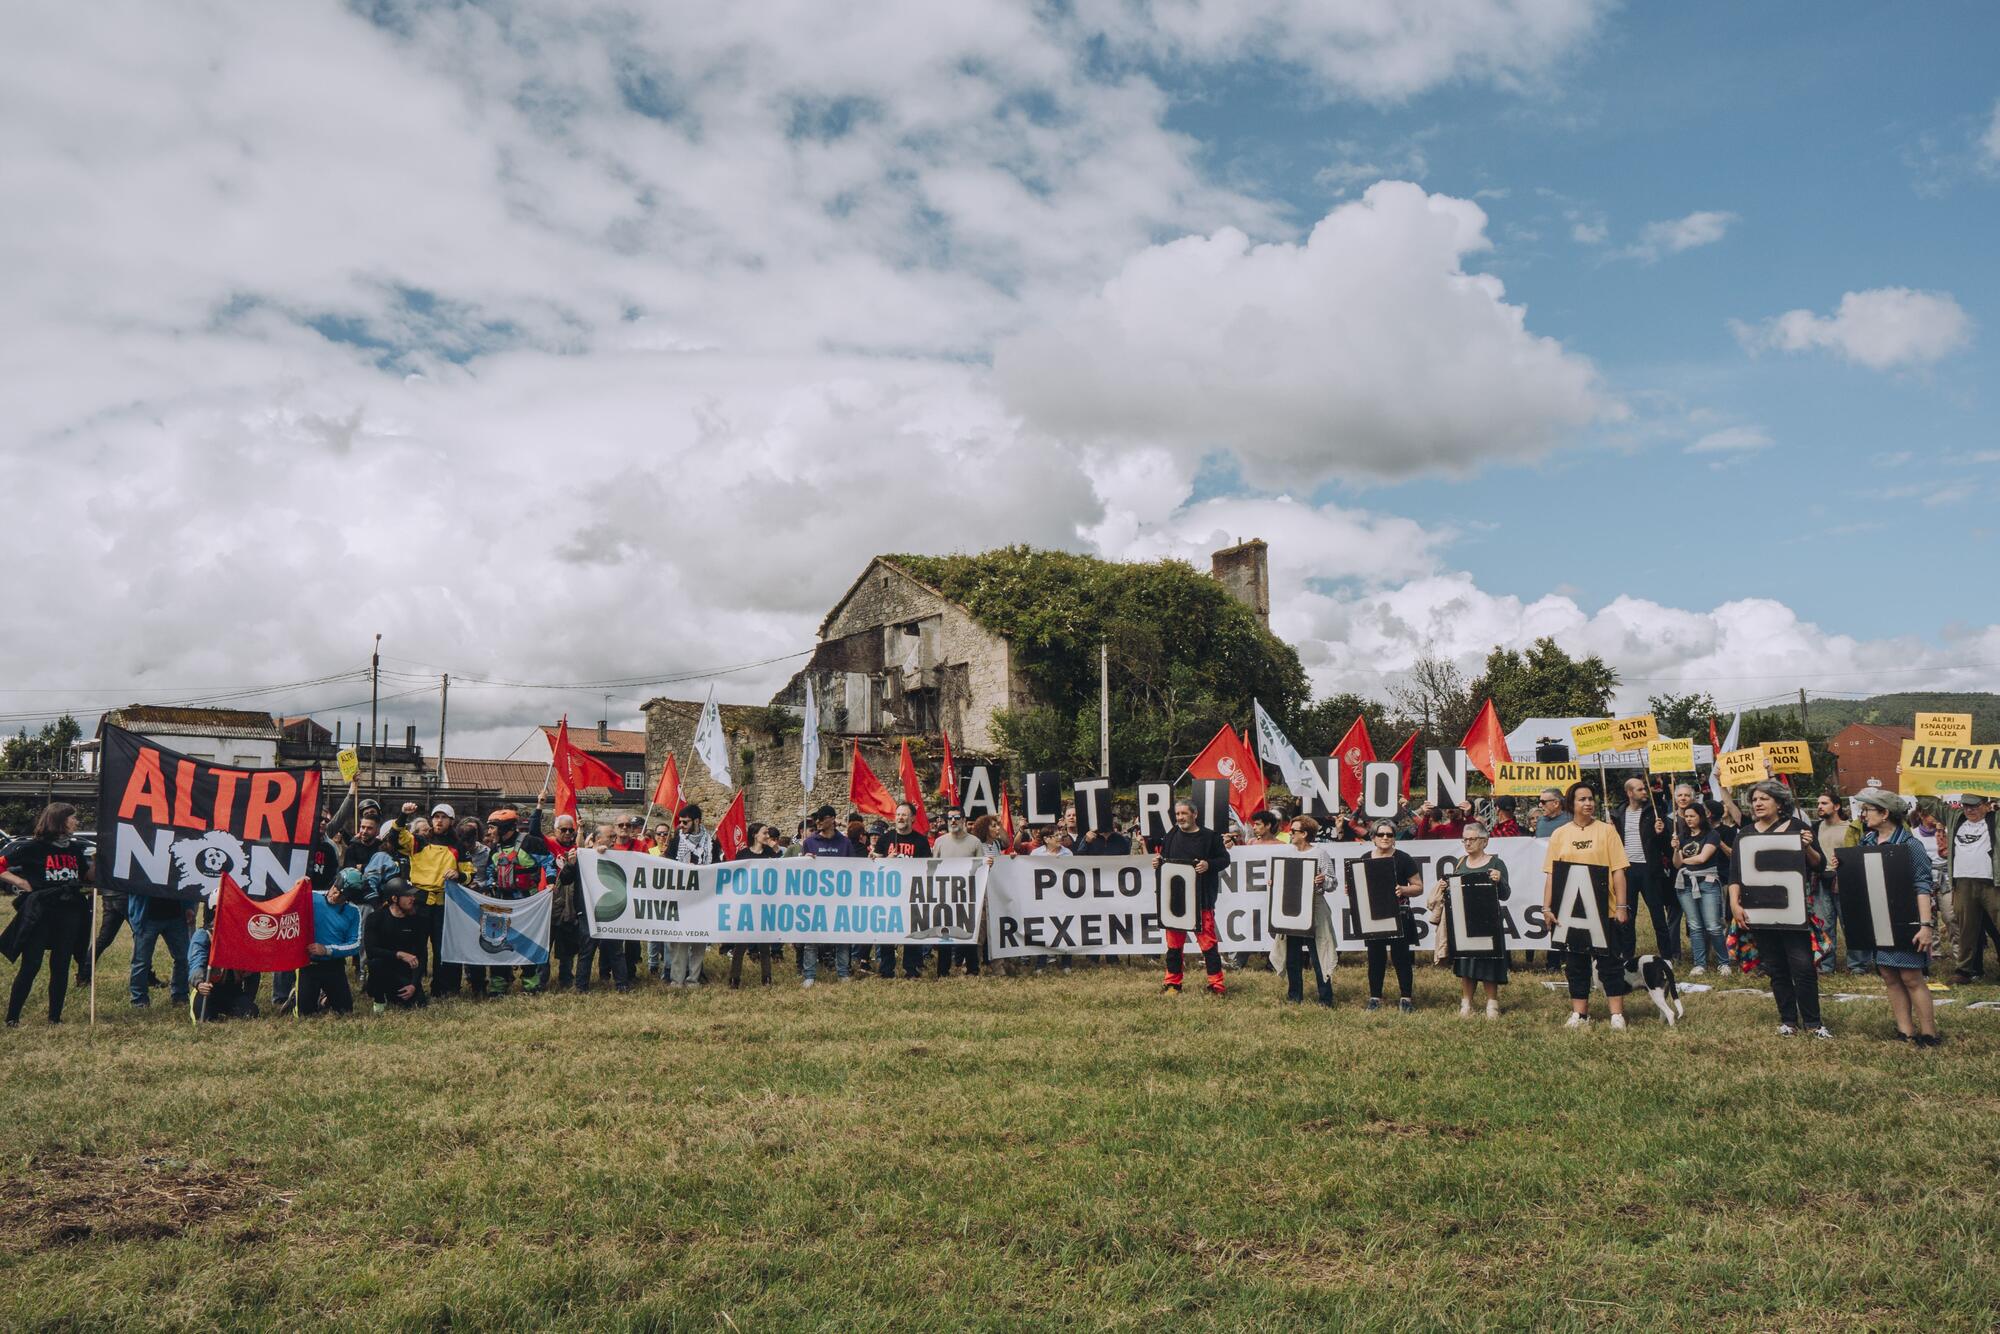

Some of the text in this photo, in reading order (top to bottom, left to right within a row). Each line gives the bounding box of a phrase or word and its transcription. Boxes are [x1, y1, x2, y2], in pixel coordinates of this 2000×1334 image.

[1576, 724, 1596, 737] ALTRI
[1618, 720, 1647, 732] ALTRI
[1622, 729, 1647, 741] NON
[1652, 742, 1672, 752] ALTRI
[1672, 741, 1689, 751] NON
[1769, 746, 1799, 755] ALTRI
[1726, 753, 1755, 765] ALTRI
[1773, 755, 1799, 764] NON
[1910, 745, 1983, 769] ALTRI
[1500, 764, 1577, 780] ALTRI NON
[1730, 763, 1754, 774] NON
[118, 746, 320, 844] ALTRI
[45, 854, 78, 869] ALTRI
[633, 867, 700, 891] A ULLA
[716, 866, 901, 898] POLO NOSO RÍO
[1034, 867, 1142, 900] POLO
[909, 876, 976, 903] ALTRI
[633, 899, 680, 921] VIVA
[280, 913, 299, 926] MINA
[718, 904, 904, 933] E A NOSA AUGA
[911, 903, 976, 933] NON
[276, 926, 300, 940] NON
